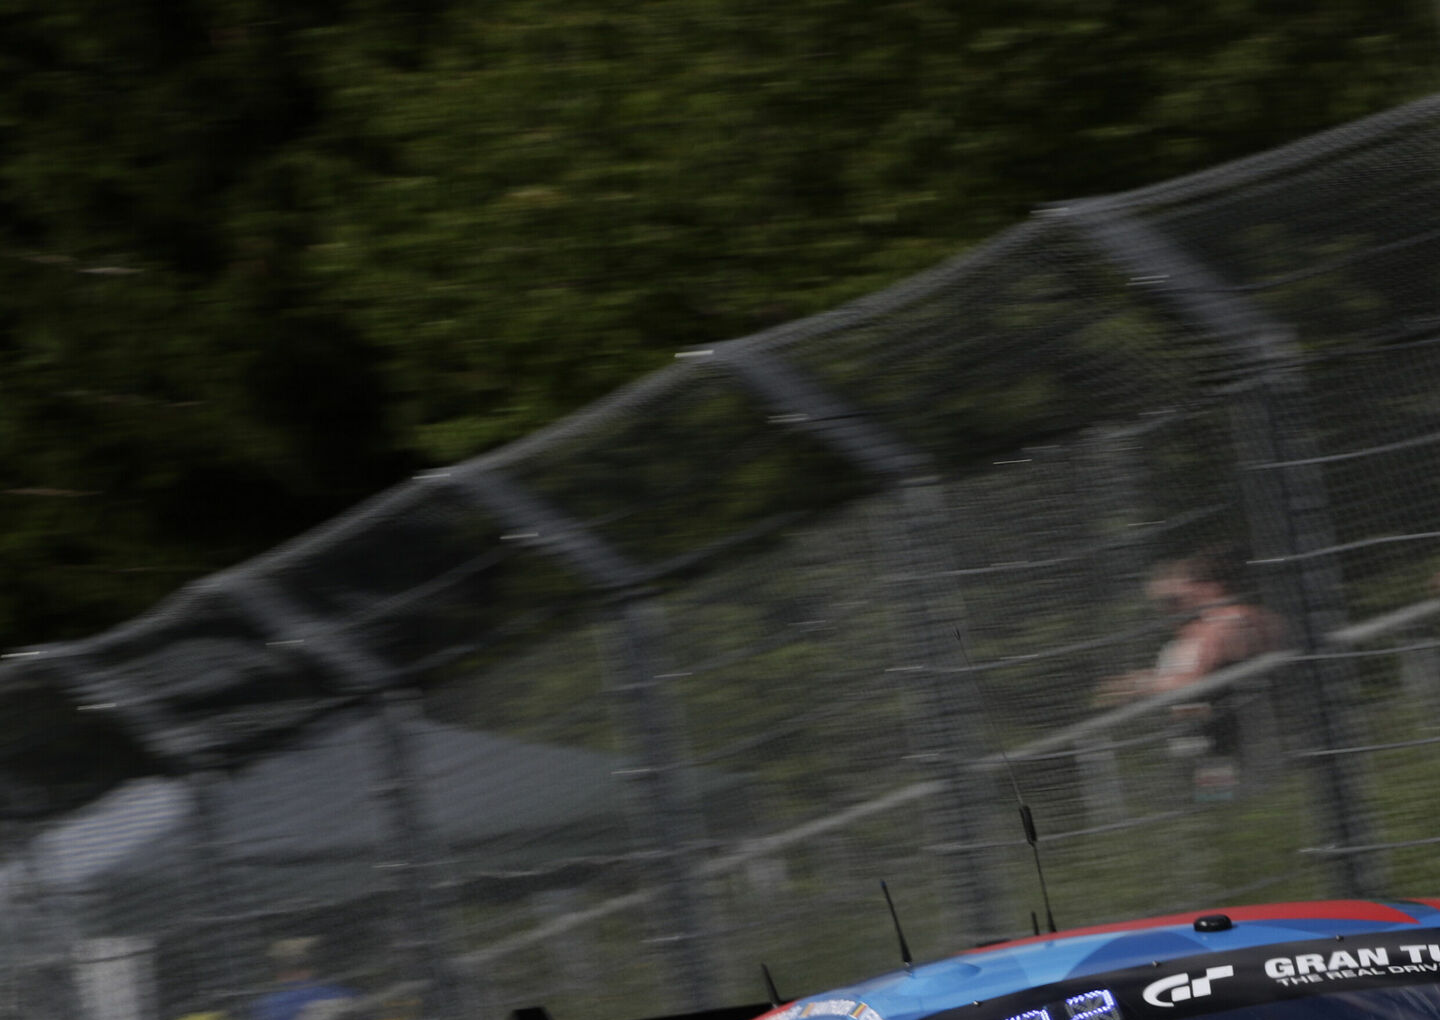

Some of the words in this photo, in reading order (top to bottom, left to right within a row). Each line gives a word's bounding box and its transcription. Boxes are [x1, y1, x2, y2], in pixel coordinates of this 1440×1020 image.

[1264, 947, 1390, 979] GRAN
[1275, 975, 1324, 988] THE
[1326, 967, 1387, 981] REAL
